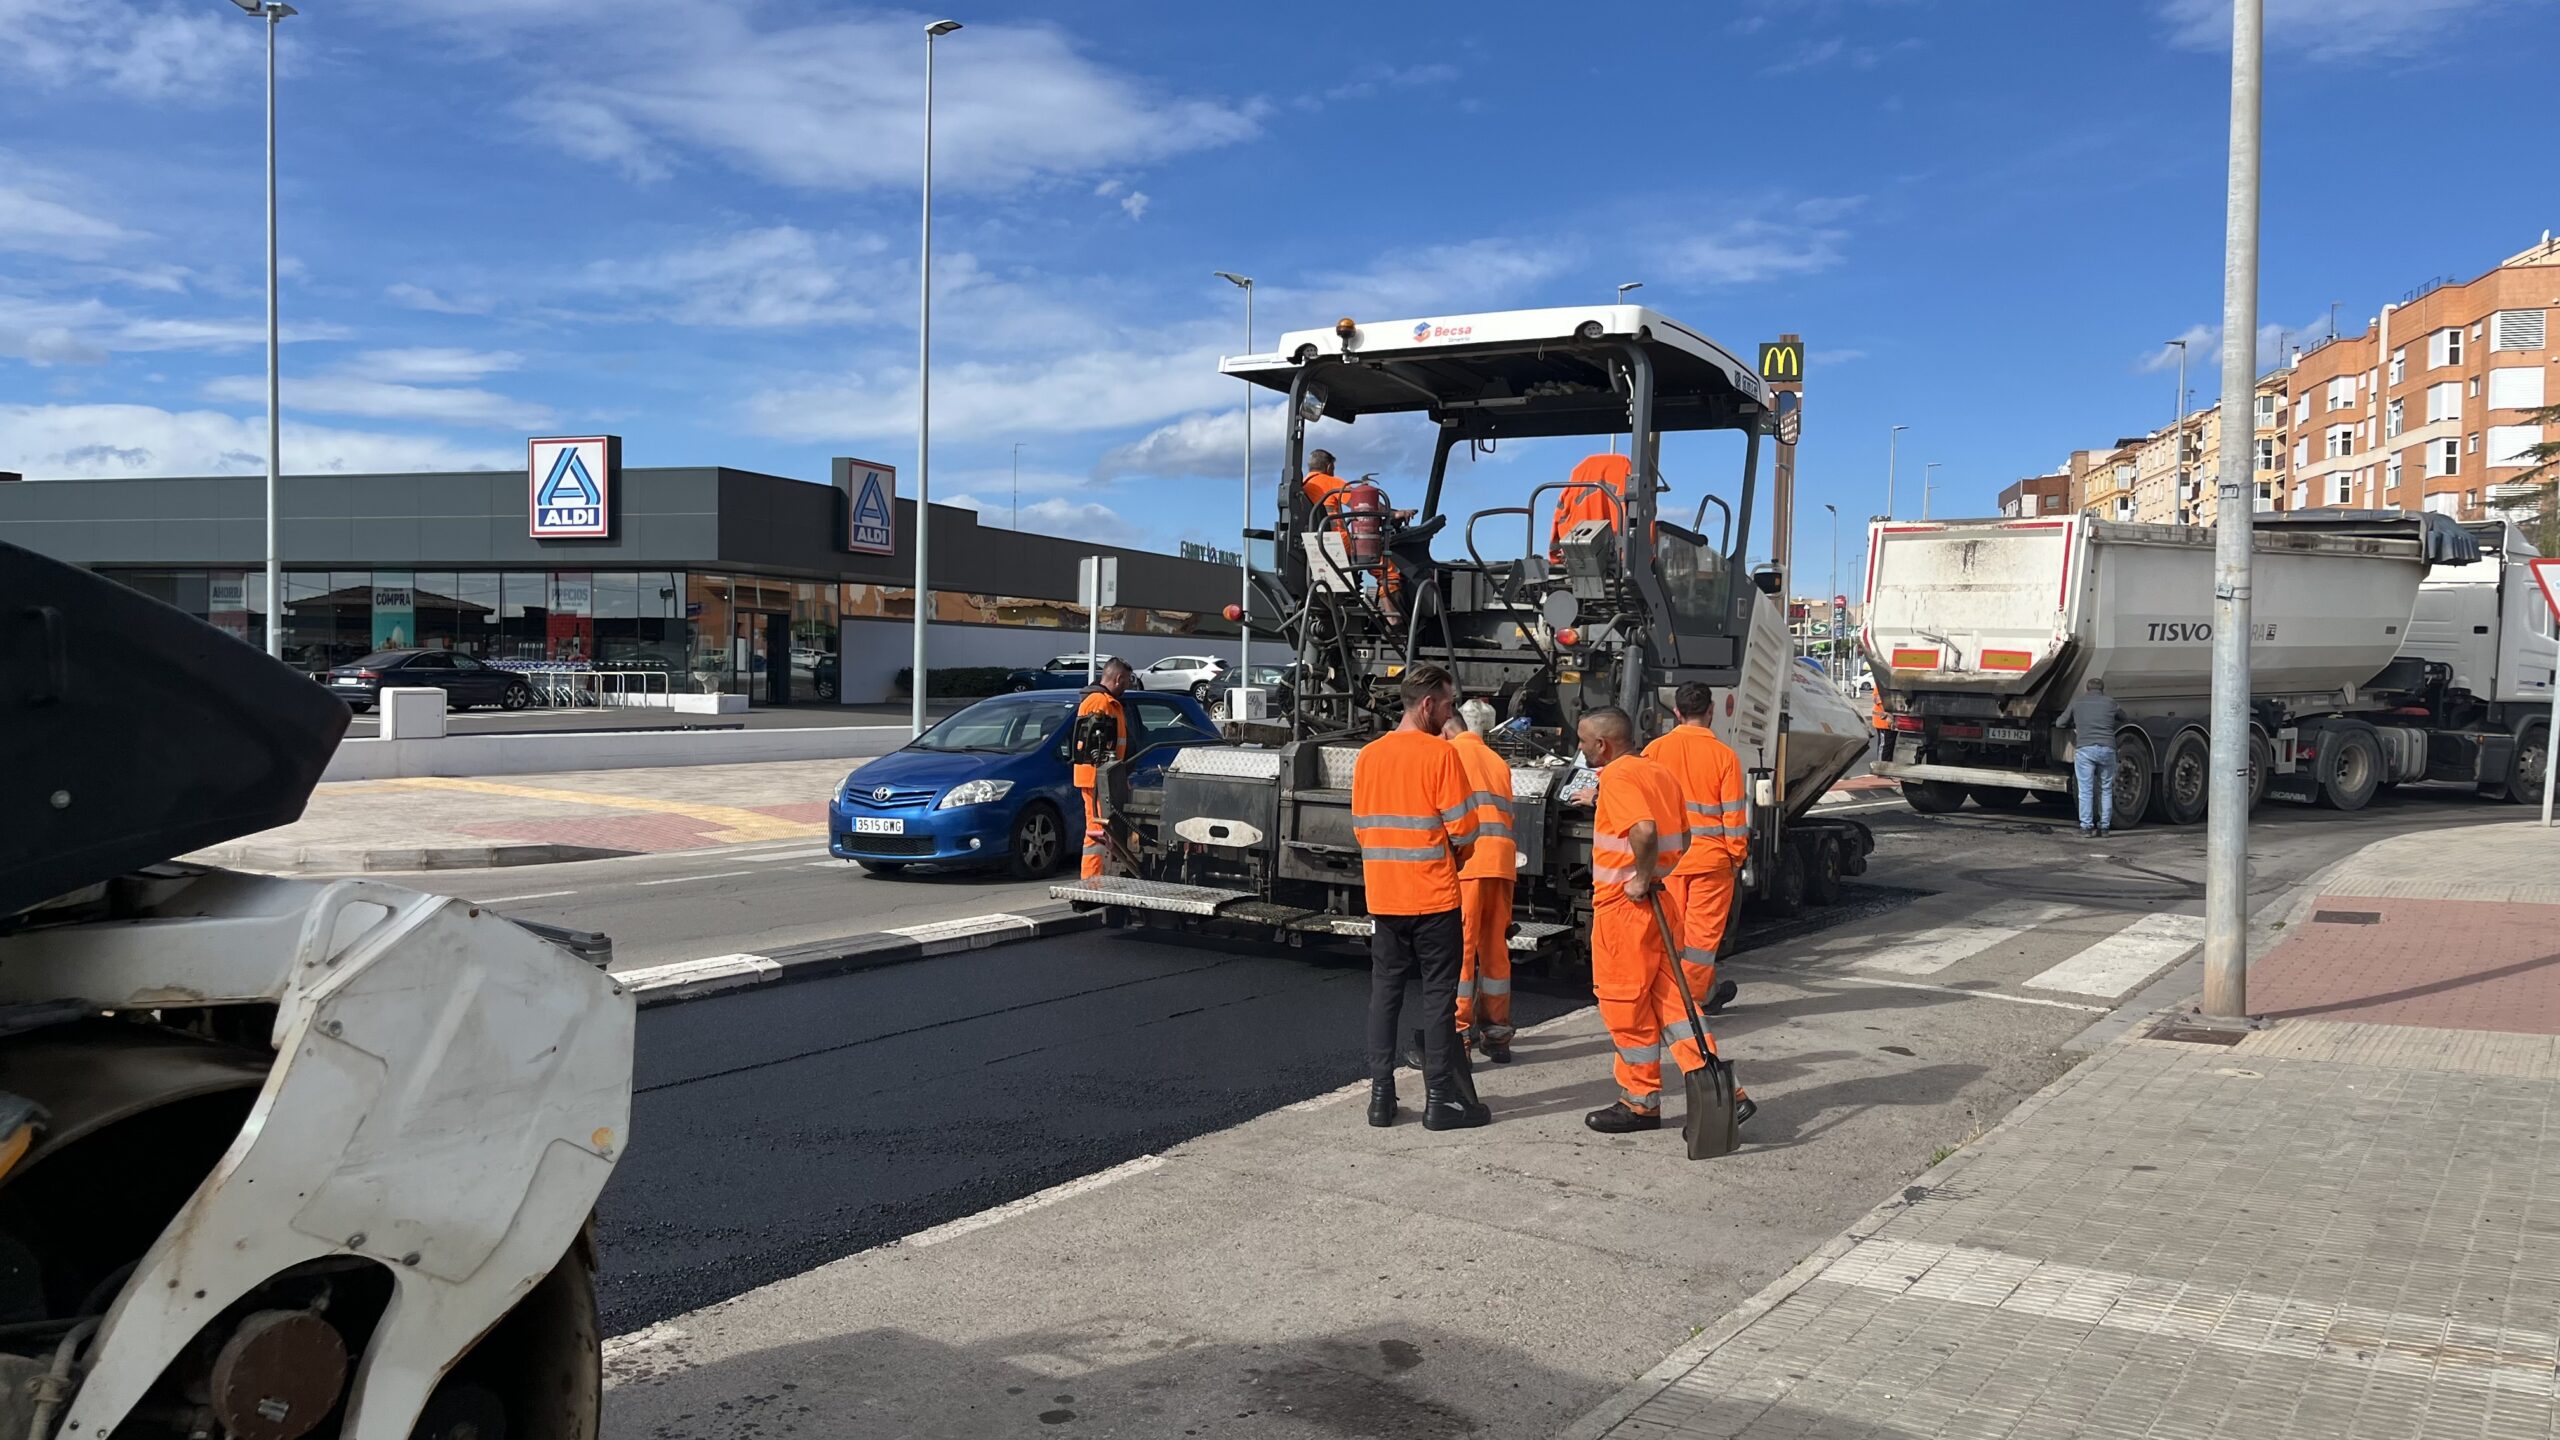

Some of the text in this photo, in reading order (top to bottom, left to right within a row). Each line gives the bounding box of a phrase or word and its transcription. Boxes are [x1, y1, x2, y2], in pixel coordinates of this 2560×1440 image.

[1435, 326, 1472, 337] Becsa
[544, 509, 595, 526] ALDI
[857, 527, 887, 544] ALDI
[376, 592, 411, 606] COMPRA
[2148, 623, 2214, 642] TISVO
[2270, 790, 2306, 801] SCANIA
[858, 819, 902, 832] 3515 GWG
